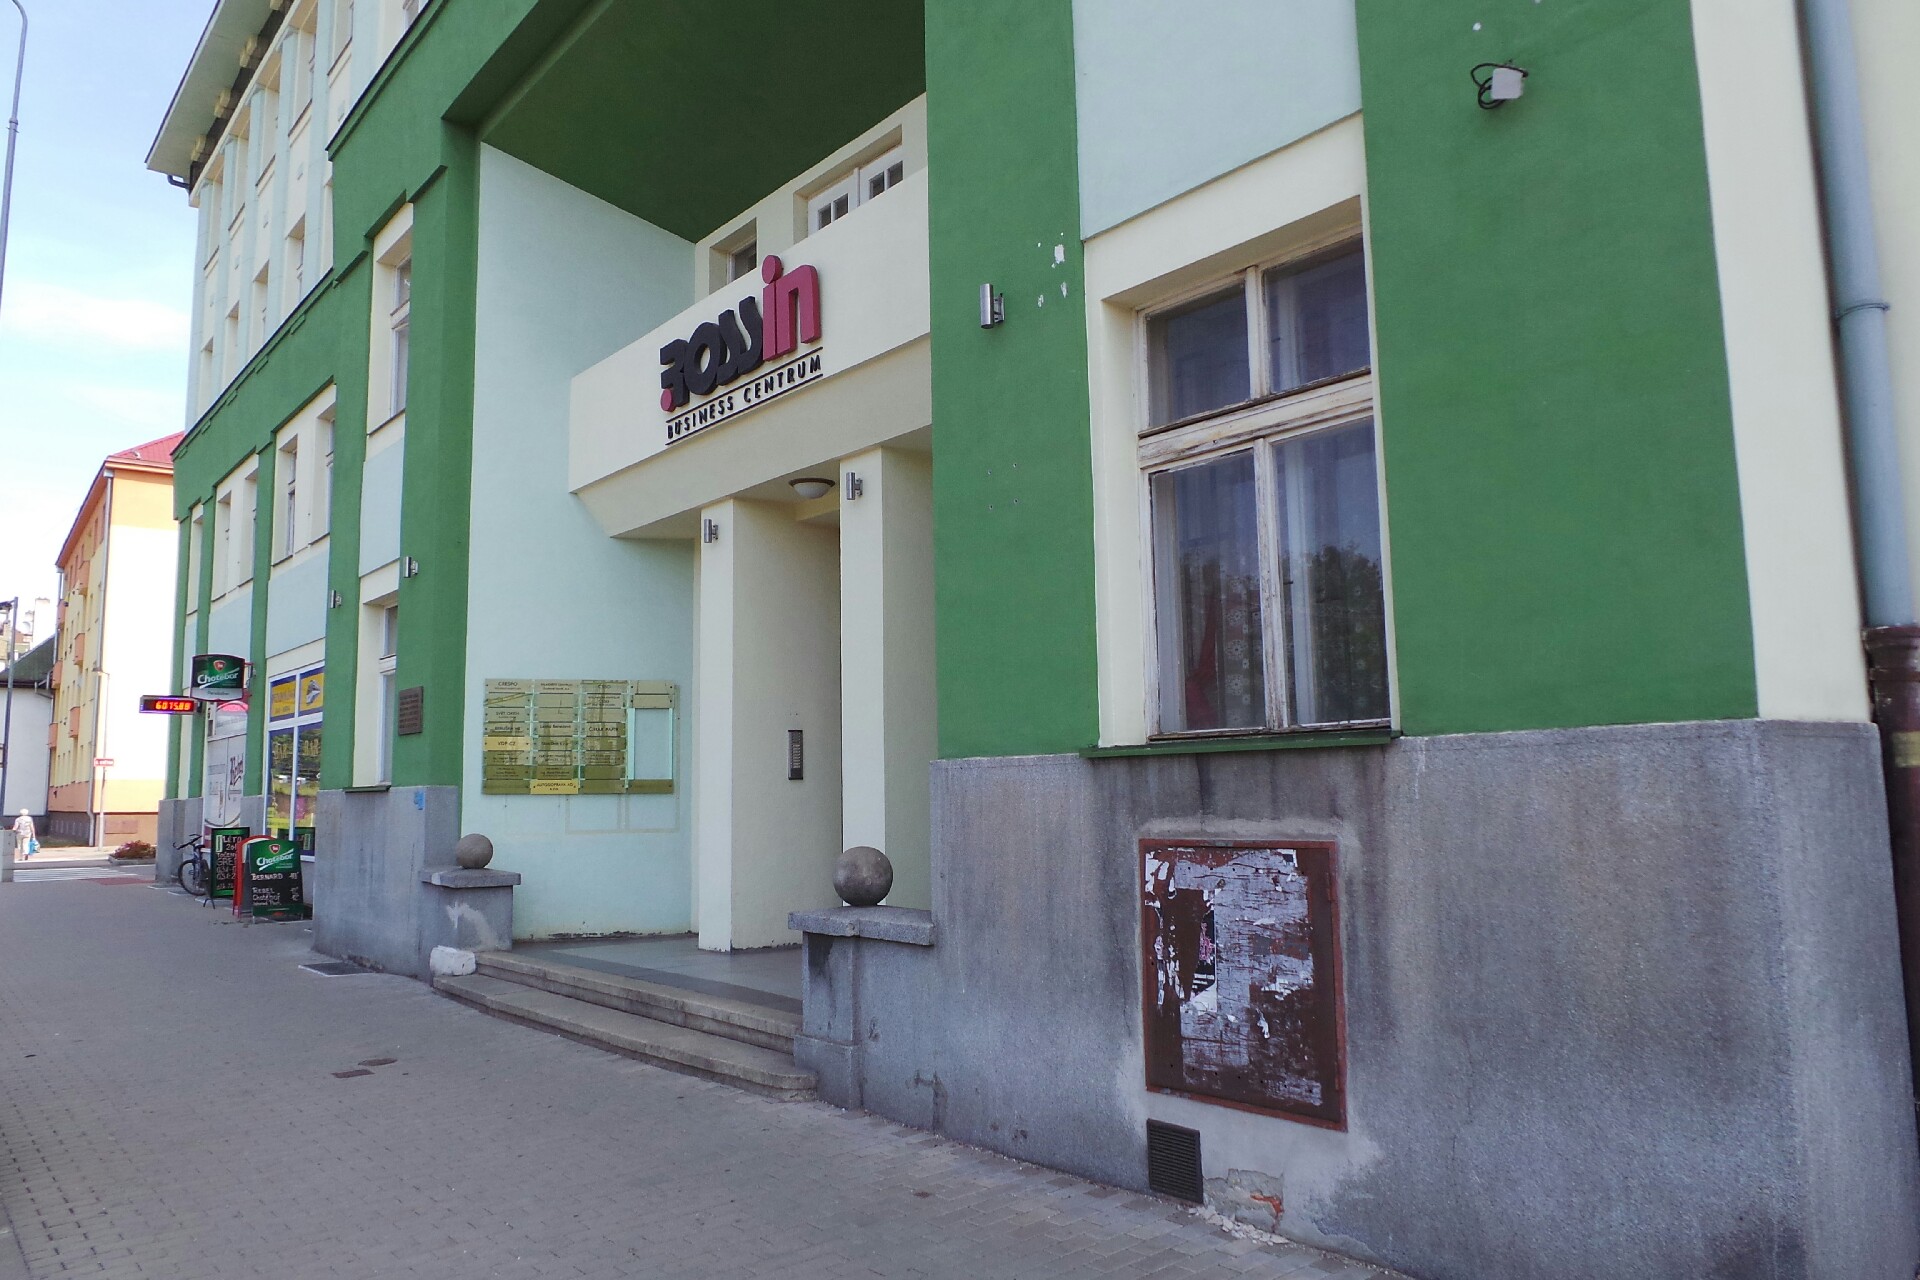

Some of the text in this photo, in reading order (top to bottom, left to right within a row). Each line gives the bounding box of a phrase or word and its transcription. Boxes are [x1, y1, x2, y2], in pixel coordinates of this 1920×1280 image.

[667, 354, 822, 440] BUSINESS CENTRUM
[250, 873, 284, 881] BERNARD
